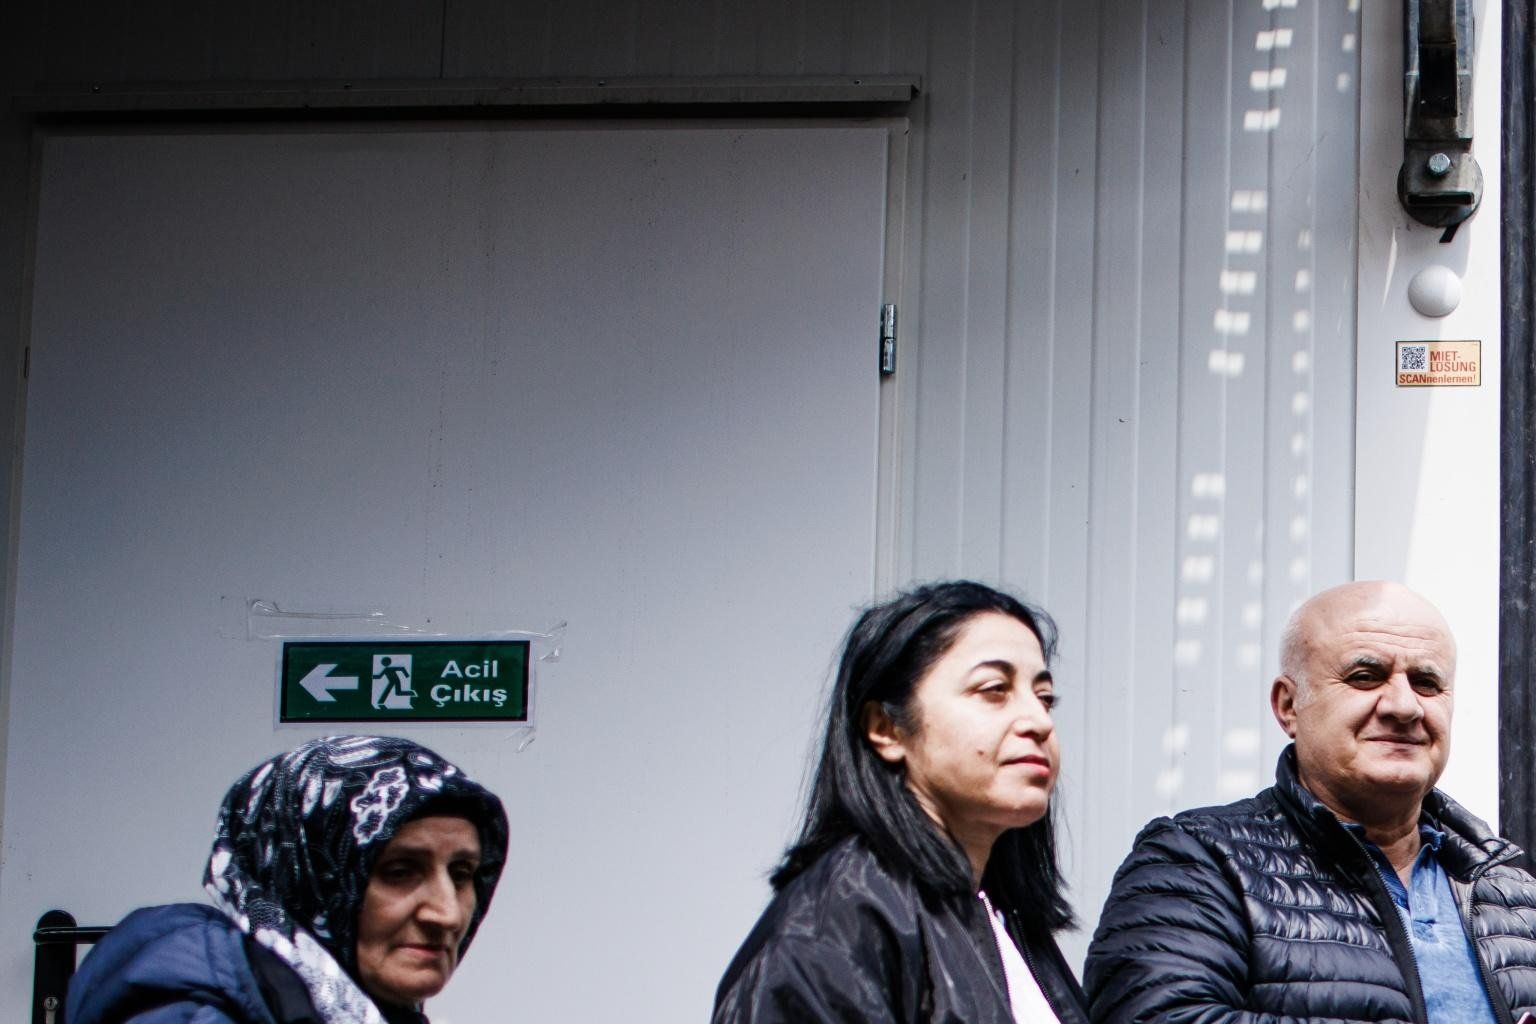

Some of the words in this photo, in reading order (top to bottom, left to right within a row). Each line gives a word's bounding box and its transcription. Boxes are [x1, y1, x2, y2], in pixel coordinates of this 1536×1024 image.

[1430, 351, 1461, 361] MIET-
[441, 660, 498, 678] Acil
[430, 684, 507, 707] Çıkış
